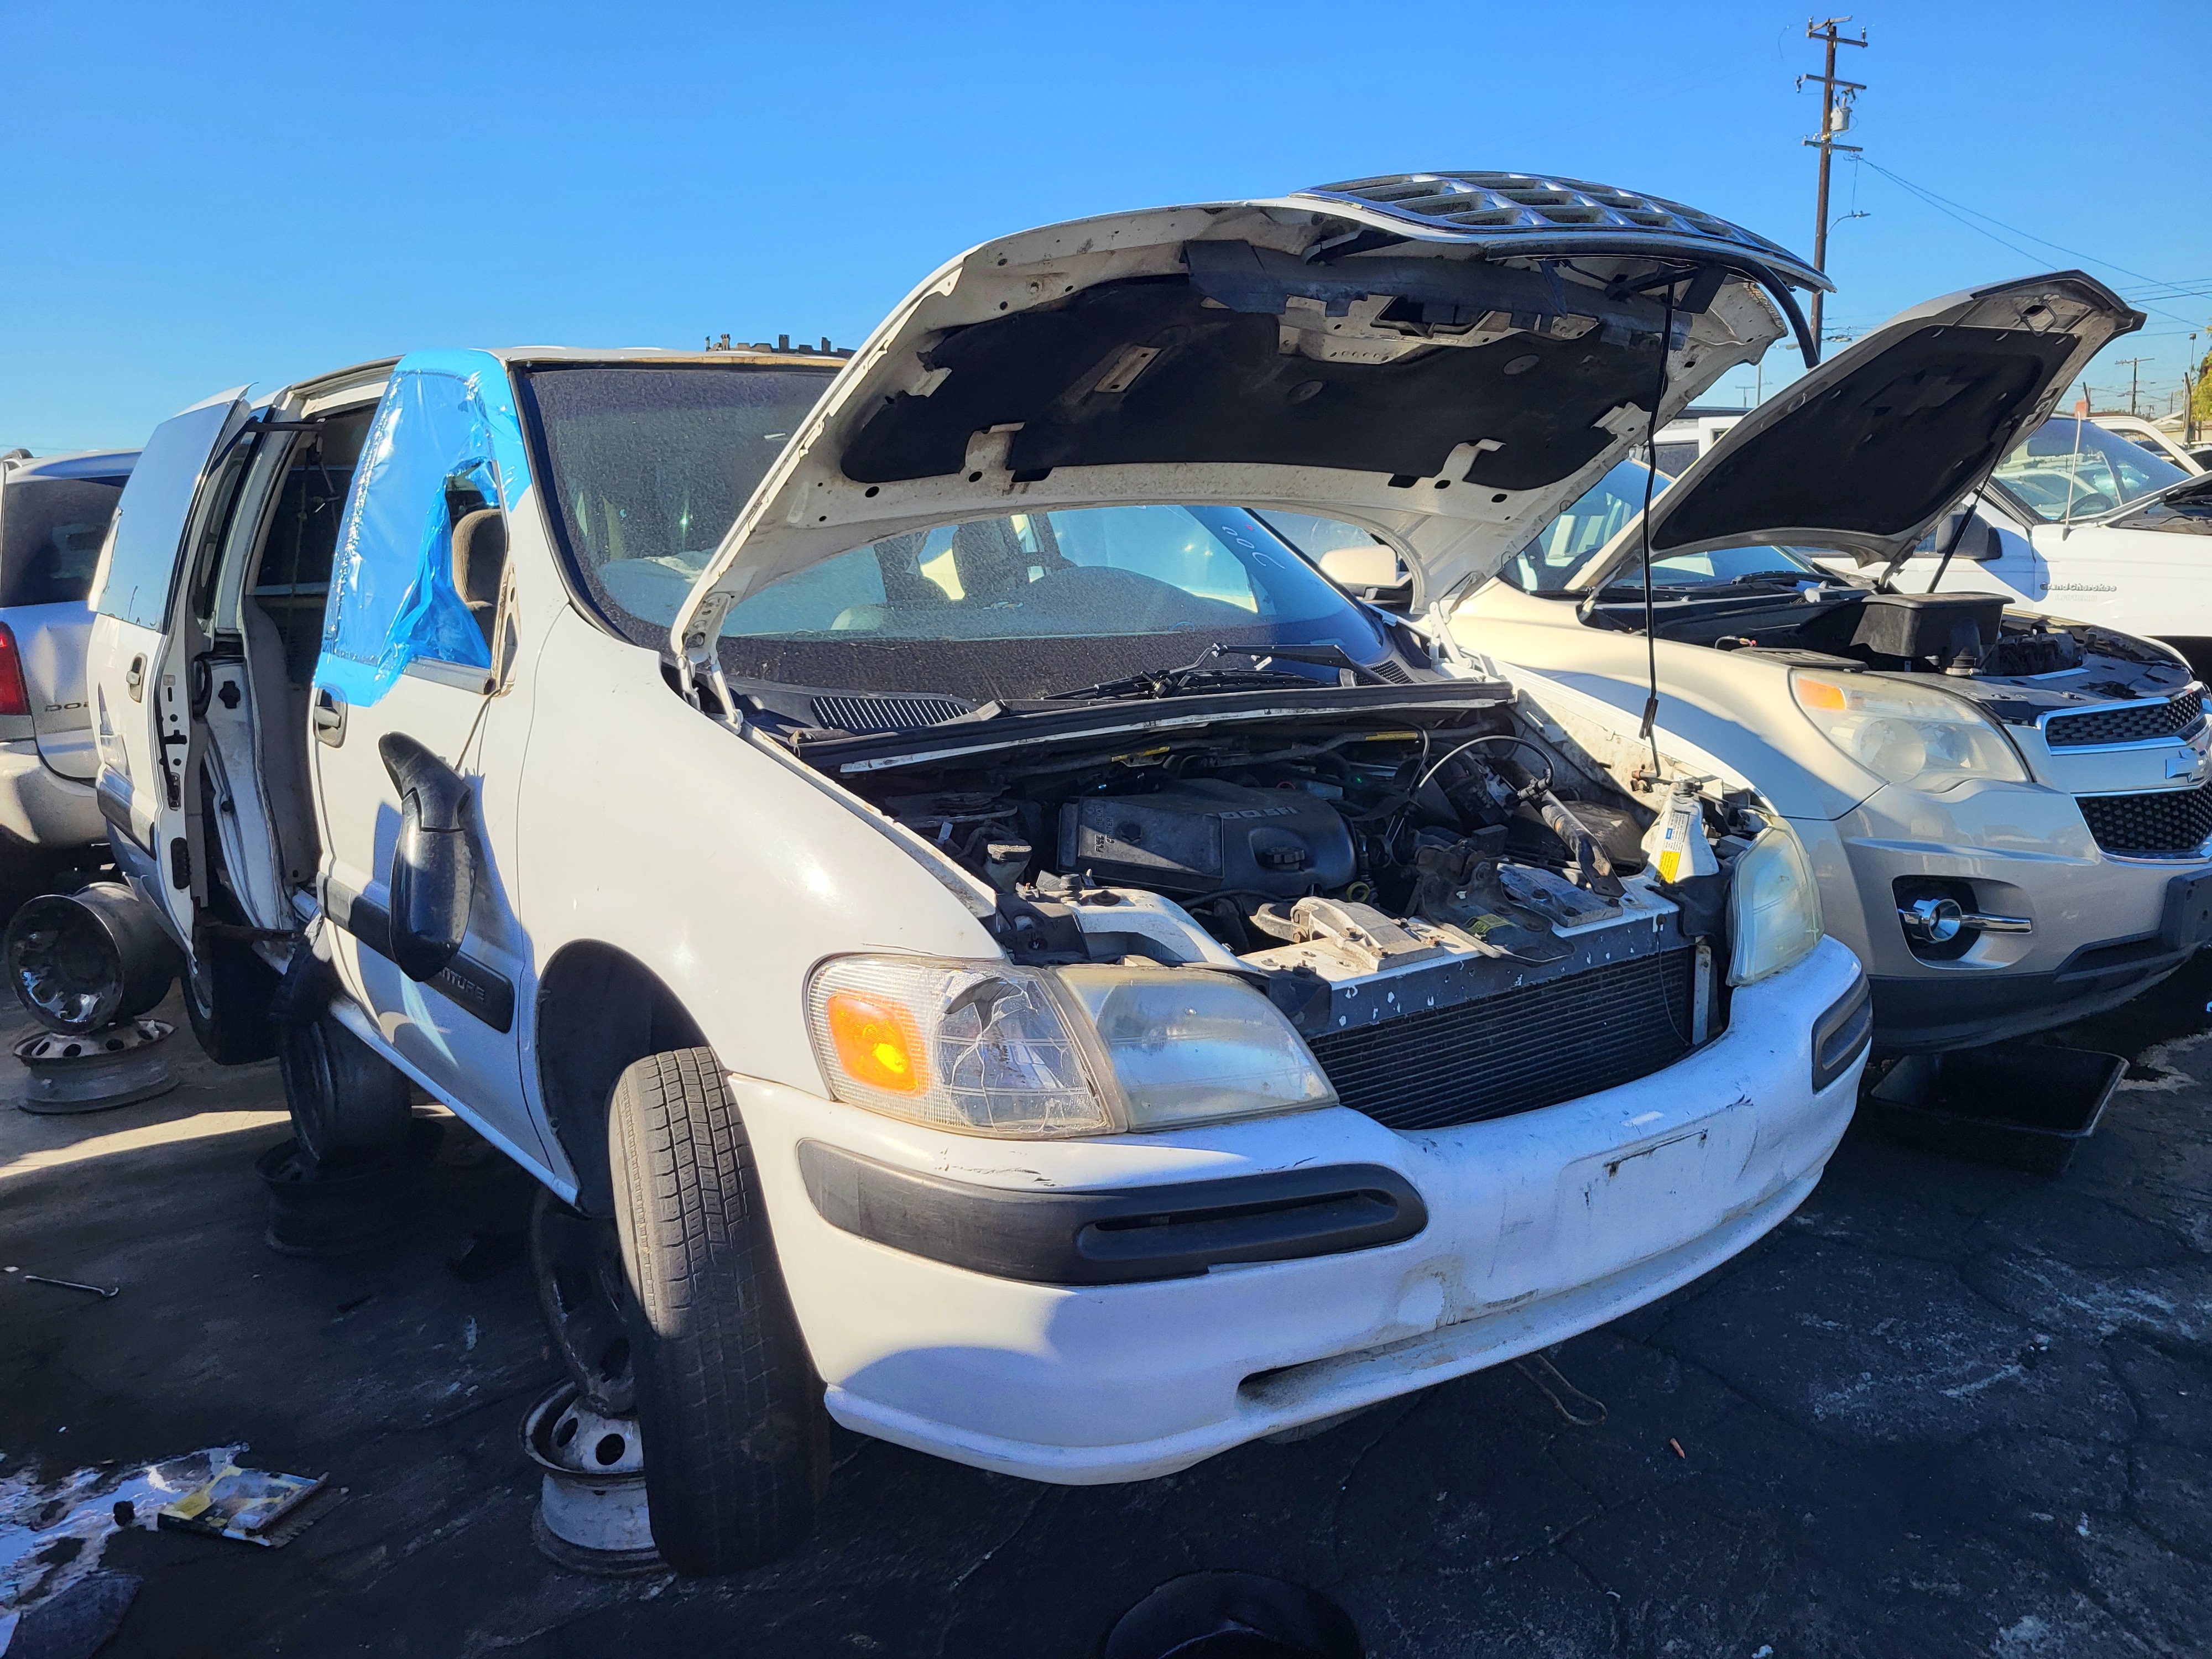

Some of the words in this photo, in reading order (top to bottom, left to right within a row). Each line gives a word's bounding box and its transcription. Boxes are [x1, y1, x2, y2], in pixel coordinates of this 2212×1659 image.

[2070, 583, 2117, 592] Cherokee
[1263, 806, 1298, 816] SFI
[1095, 834, 1105, 853] FUSE
[440, 967, 486, 1003] NTURE
